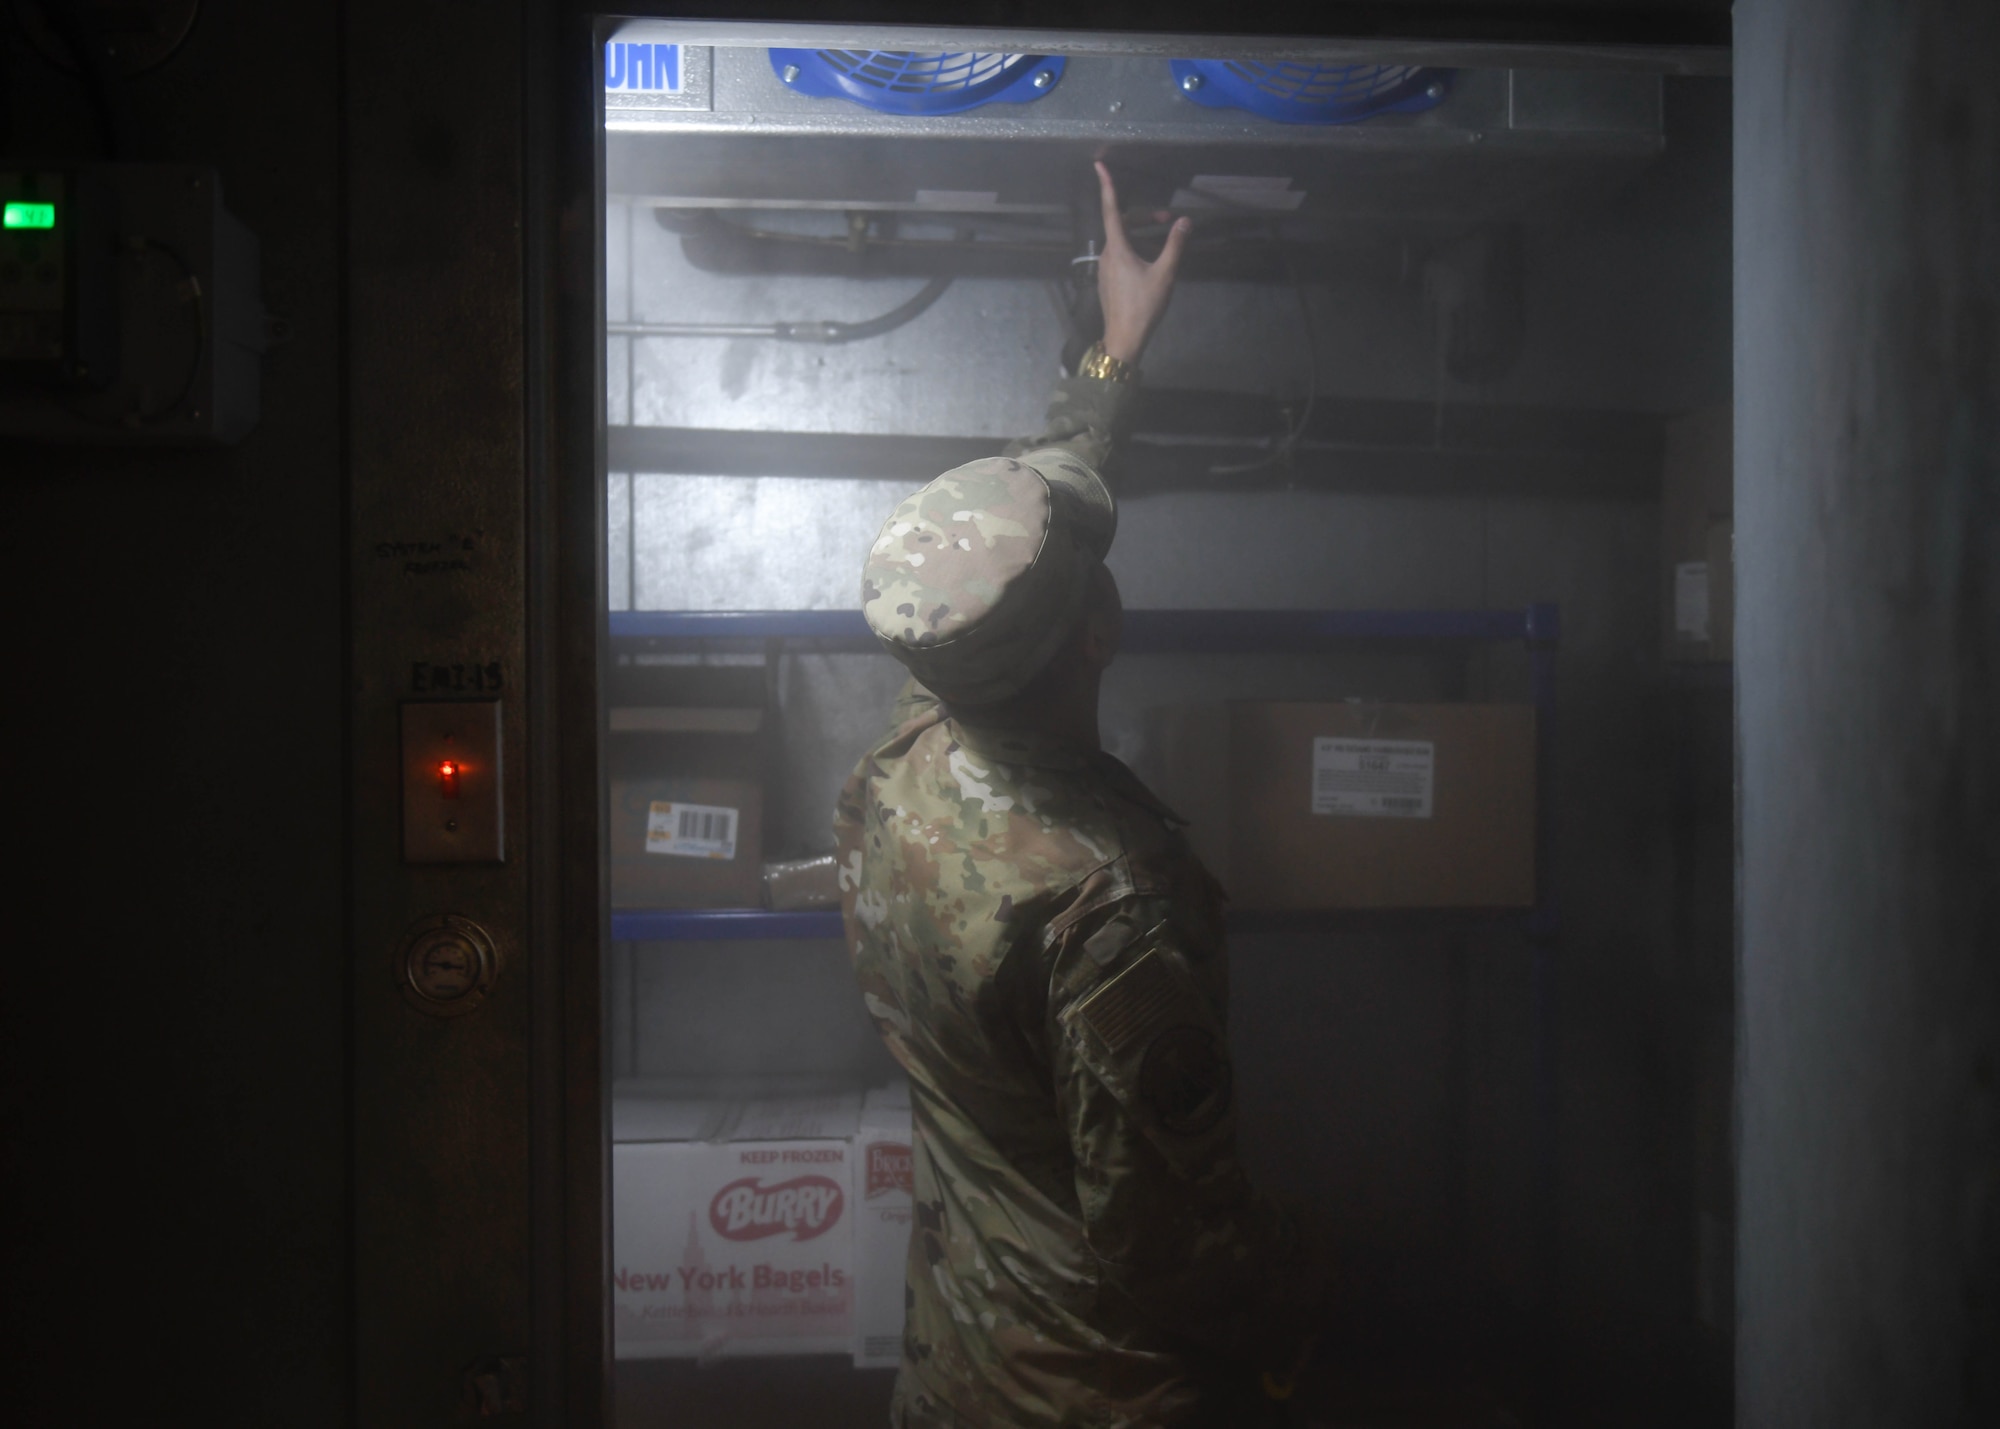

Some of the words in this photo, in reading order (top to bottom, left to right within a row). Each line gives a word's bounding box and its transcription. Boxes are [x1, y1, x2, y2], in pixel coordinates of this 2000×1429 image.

[740, 1150, 779, 1165] KEEP
[782, 1149, 845, 1164] FROZEN
[717, 1184, 838, 1232] BURRY
[613, 1266, 670, 1293] New
[677, 1265, 745, 1291] York
[752, 1262, 845, 1293] Bagels
